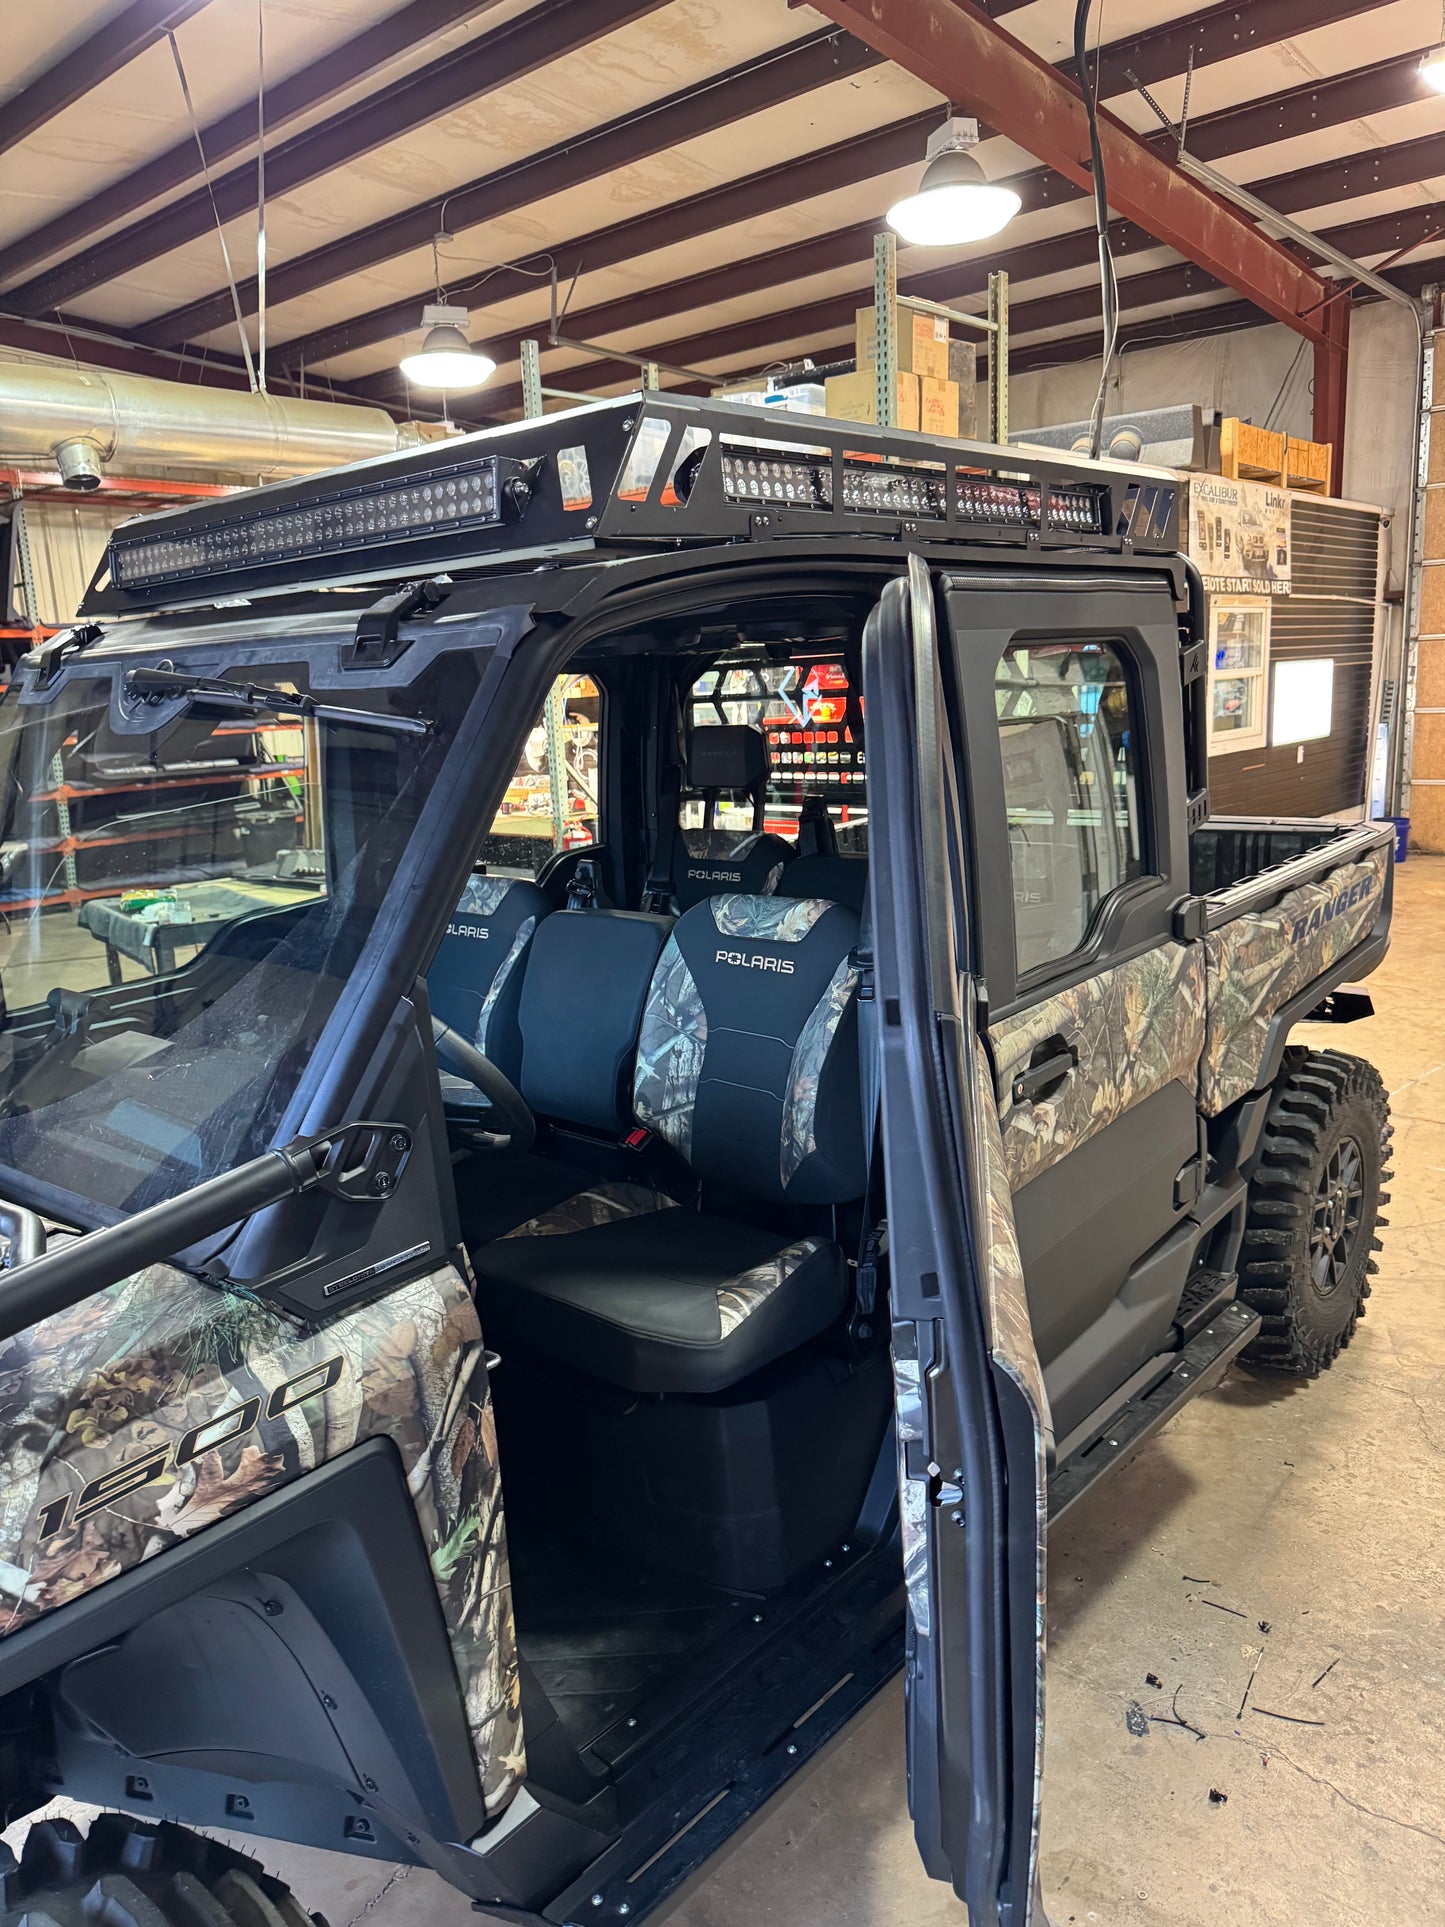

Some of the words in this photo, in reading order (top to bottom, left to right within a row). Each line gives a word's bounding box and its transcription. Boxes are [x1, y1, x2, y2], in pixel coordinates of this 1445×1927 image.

[1193, 479, 1238, 500] EXCALIBUR
[1253, 579, 1270, 594] SOLD
[1271, 580, 1292, 595] HER
[687, 869, 742, 882] POLARIS
[1291, 875, 1373, 945] RANGER
[715, 950, 795, 975] POLARIS
[36, 1354, 345, 1545] 1500
